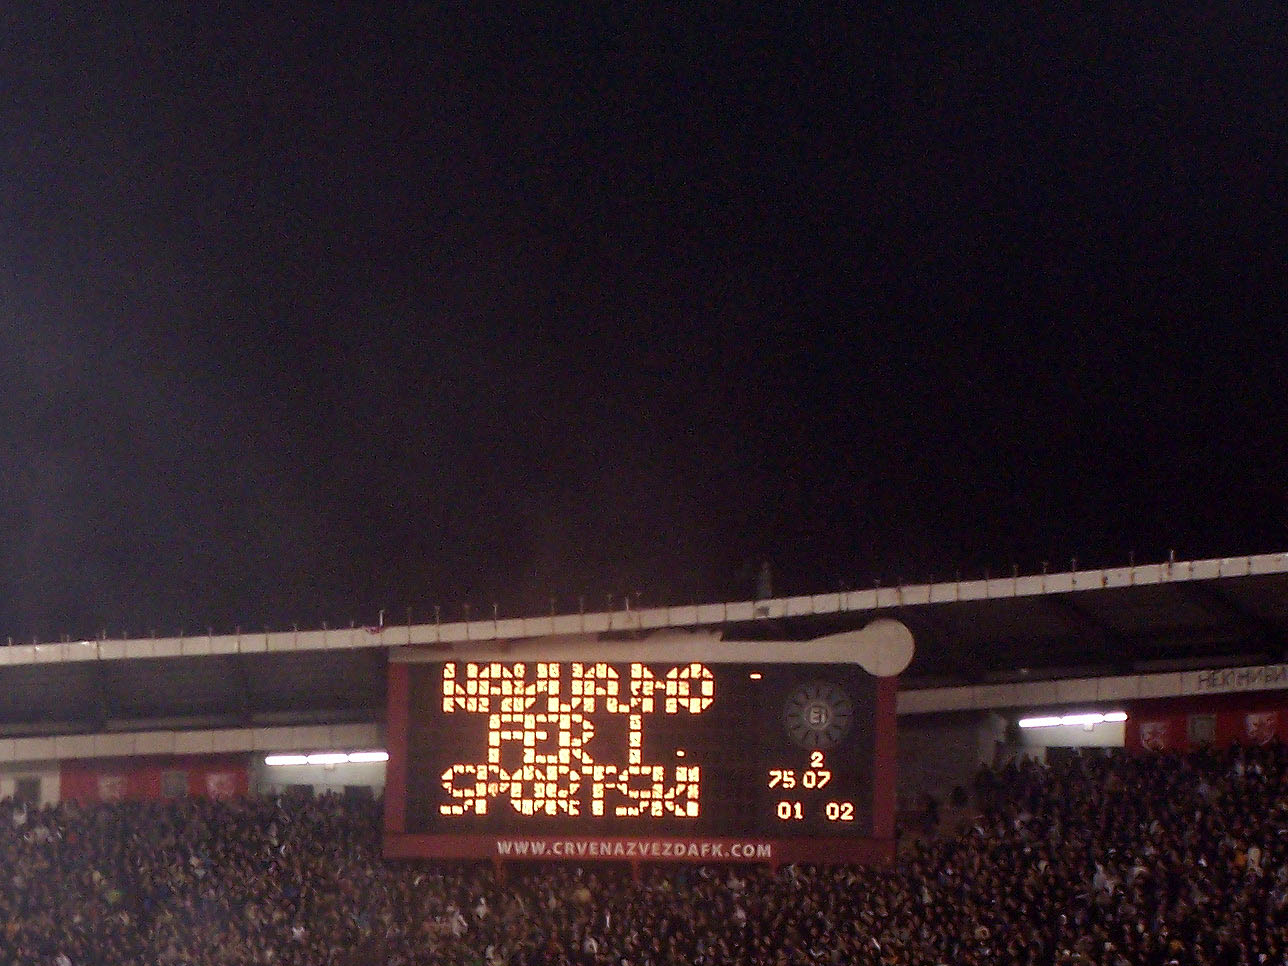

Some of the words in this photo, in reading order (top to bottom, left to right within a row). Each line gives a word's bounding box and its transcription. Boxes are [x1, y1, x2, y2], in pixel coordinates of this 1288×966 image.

[810, 751, 824, 768] 2
[768, 770, 796, 789] 75
[803, 770, 831, 789] 07
[777, 801, 803, 820] 01
[826, 802, 854, 821] 02
[497, 840, 772, 858] WWW.CRVENAZVEZDAFK.COM
